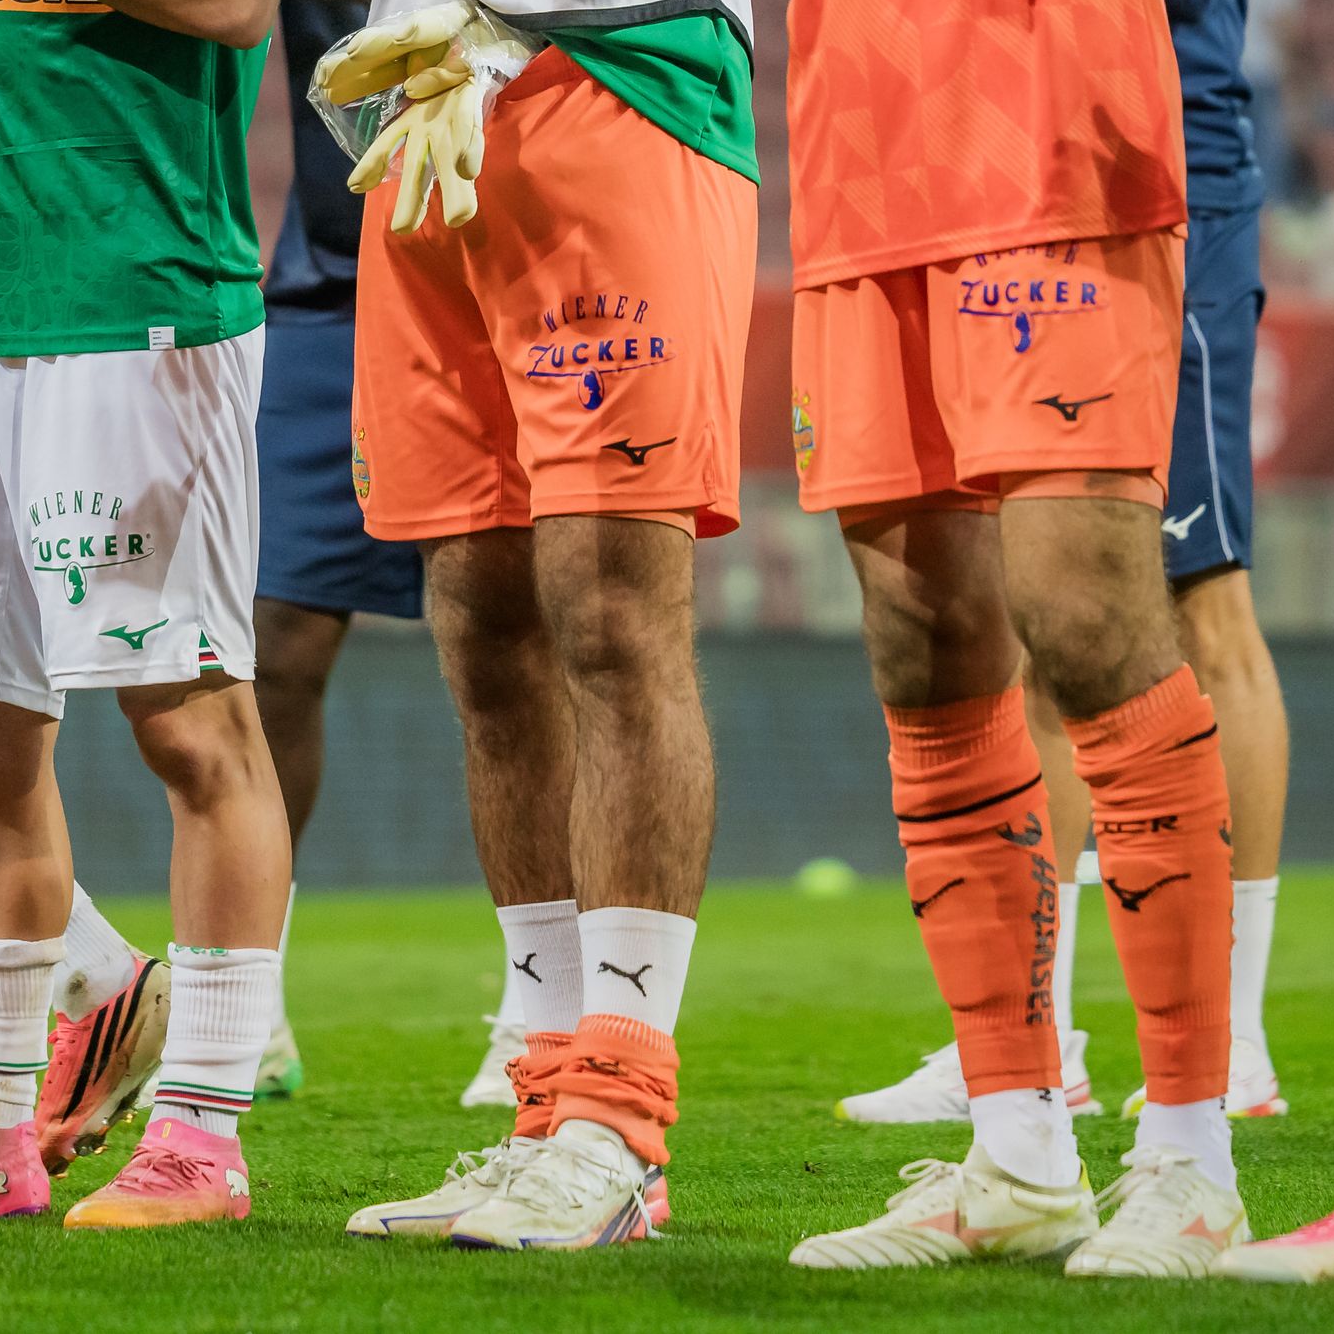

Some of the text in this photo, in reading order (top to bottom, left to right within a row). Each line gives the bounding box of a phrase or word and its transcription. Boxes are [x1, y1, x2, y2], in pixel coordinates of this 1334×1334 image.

[543, 294, 649, 333] WIENER
[959, 280, 1097, 310] ZUCKER
[527, 337, 665, 377] ZUCKER
[28, 490, 123, 527] WIENER
[31, 533, 144, 563] UCKER
